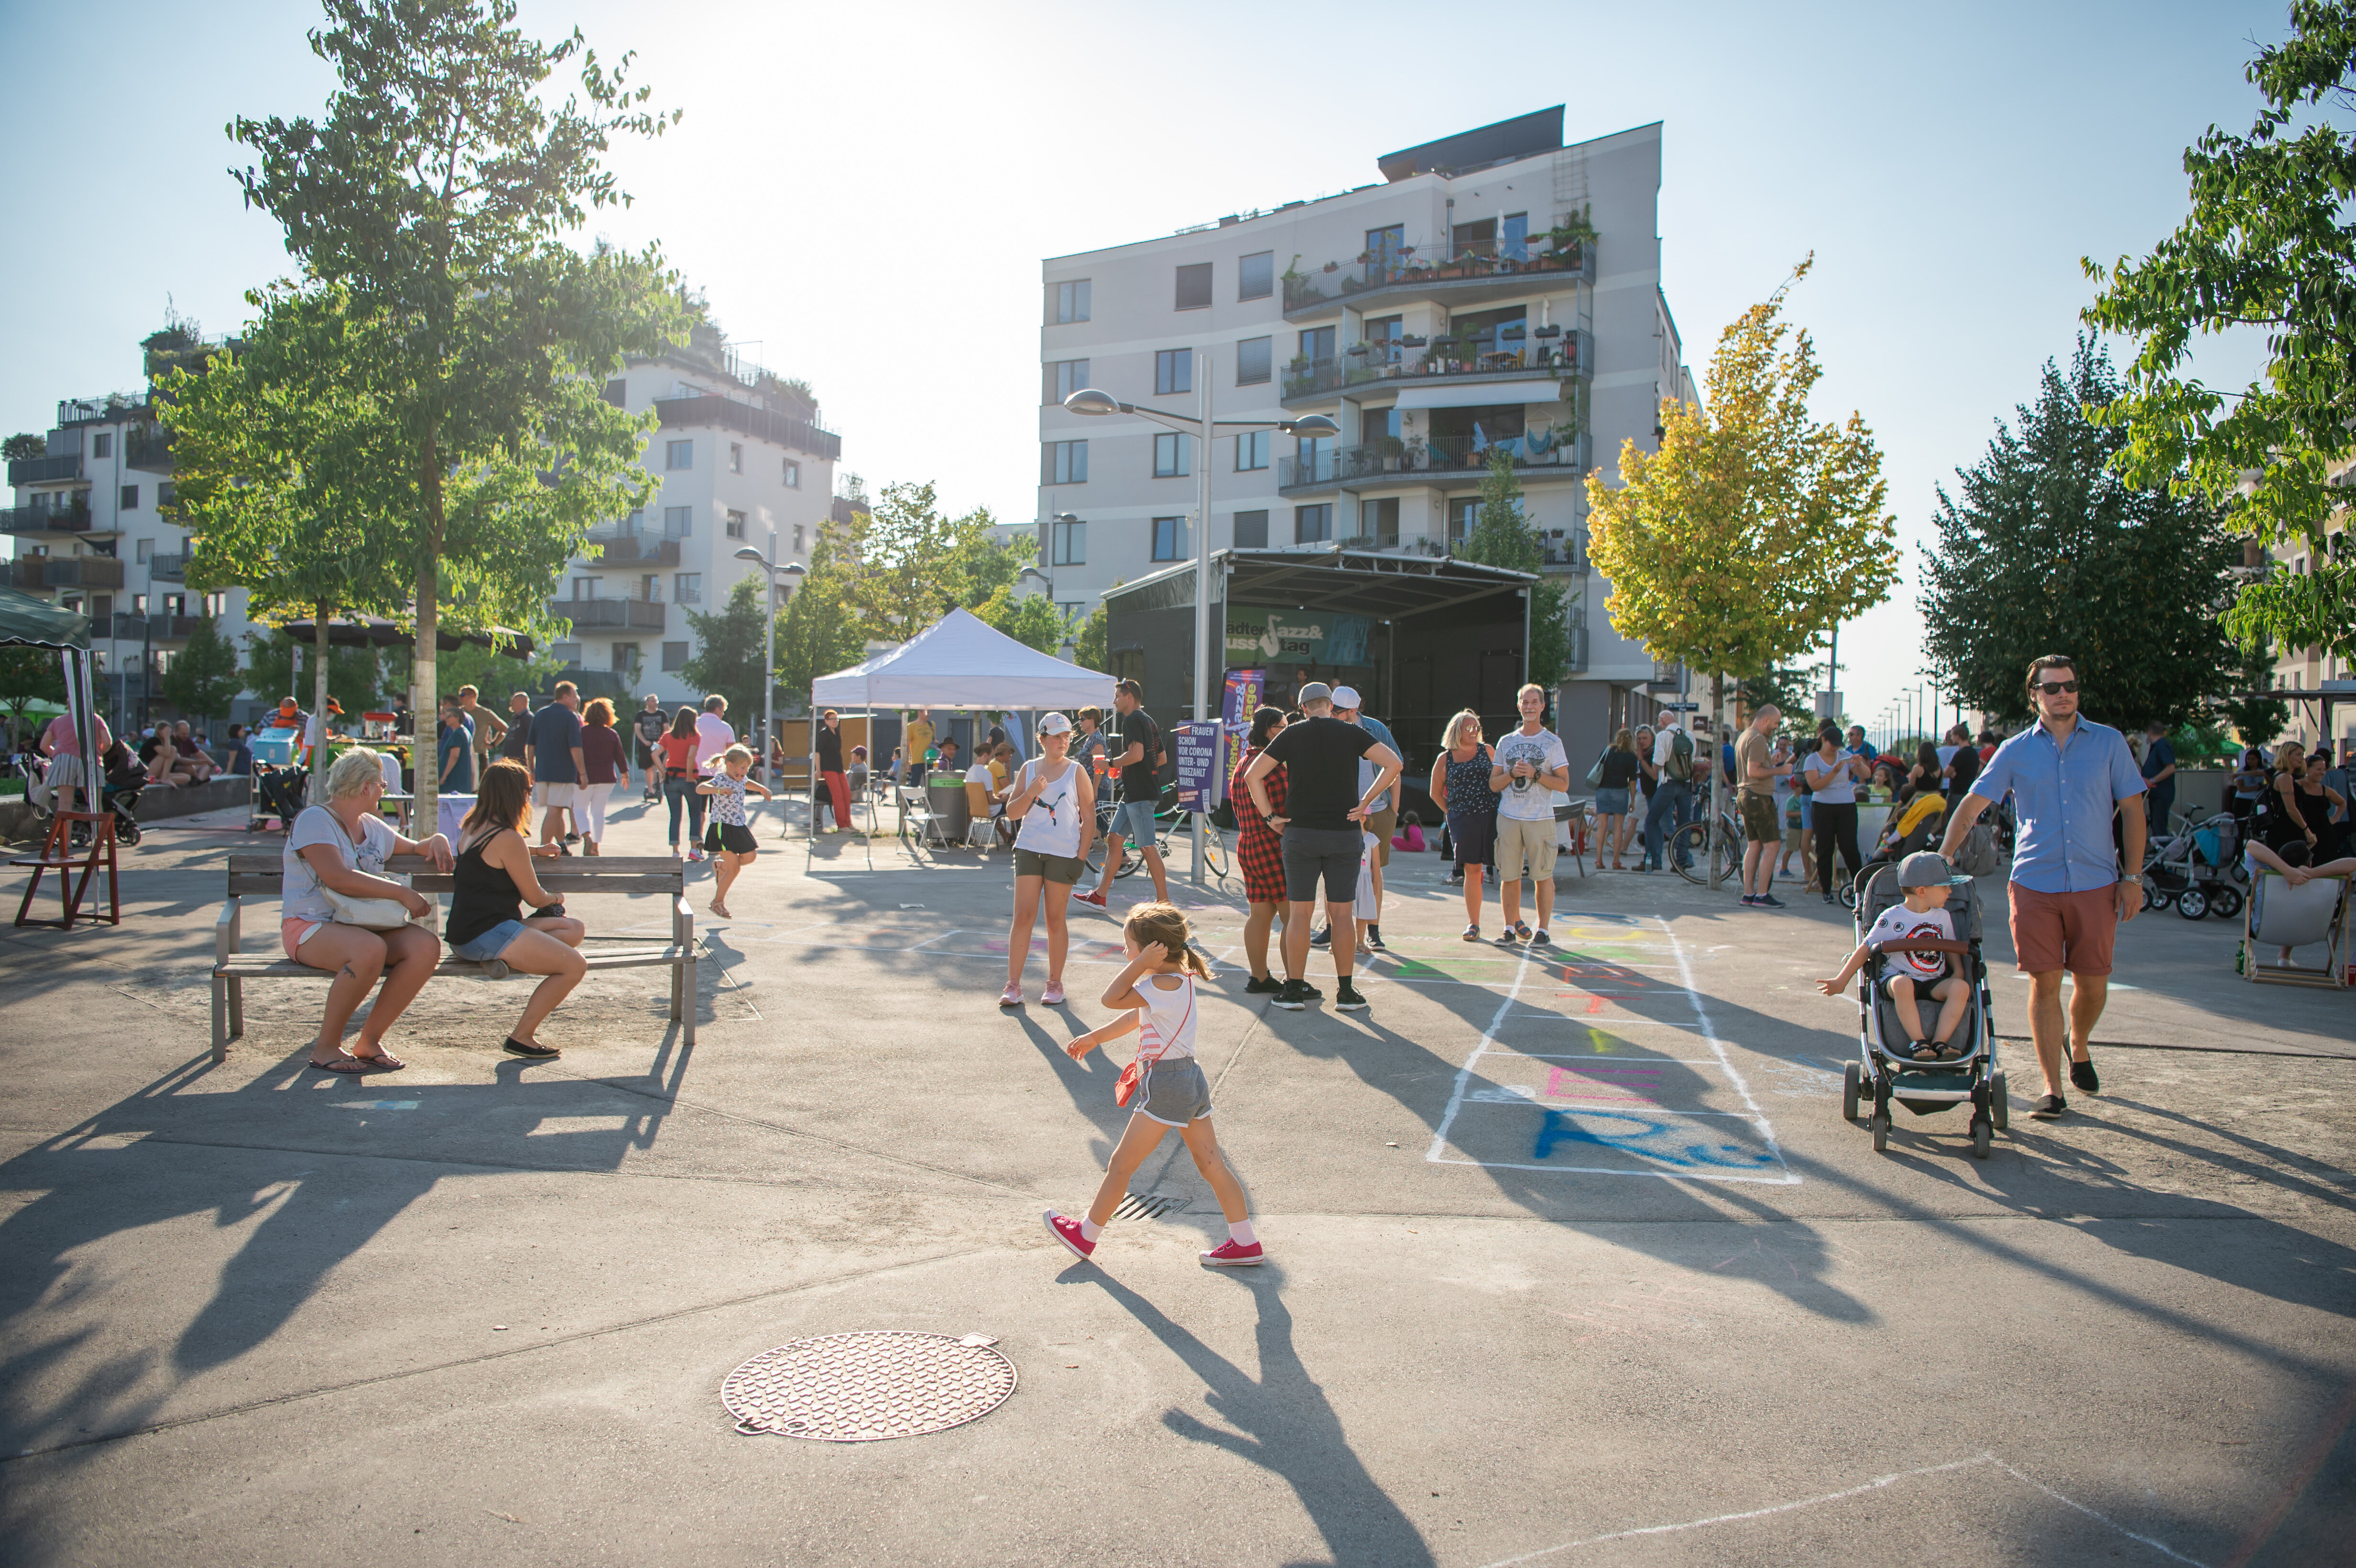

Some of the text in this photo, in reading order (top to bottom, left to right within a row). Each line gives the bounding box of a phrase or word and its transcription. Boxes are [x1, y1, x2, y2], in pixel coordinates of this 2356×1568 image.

[1226, 620, 1265, 636] ädter
[1226, 638, 1311, 655] uss tag
[1243, 683, 1257, 722] tage
[1191, 727, 1214, 736] FRAUEN
[1178, 736, 1197, 745] SCHON
[1178, 746, 1212, 757] VOR CORONA
[1226, 733, 1240, 780] wiener
[1178, 757, 1209, 767] UNTER- UND
[1178, 767, 1206, 777] UNBEZAHLT
[1179, 777, 1196, 787] WAREN.
